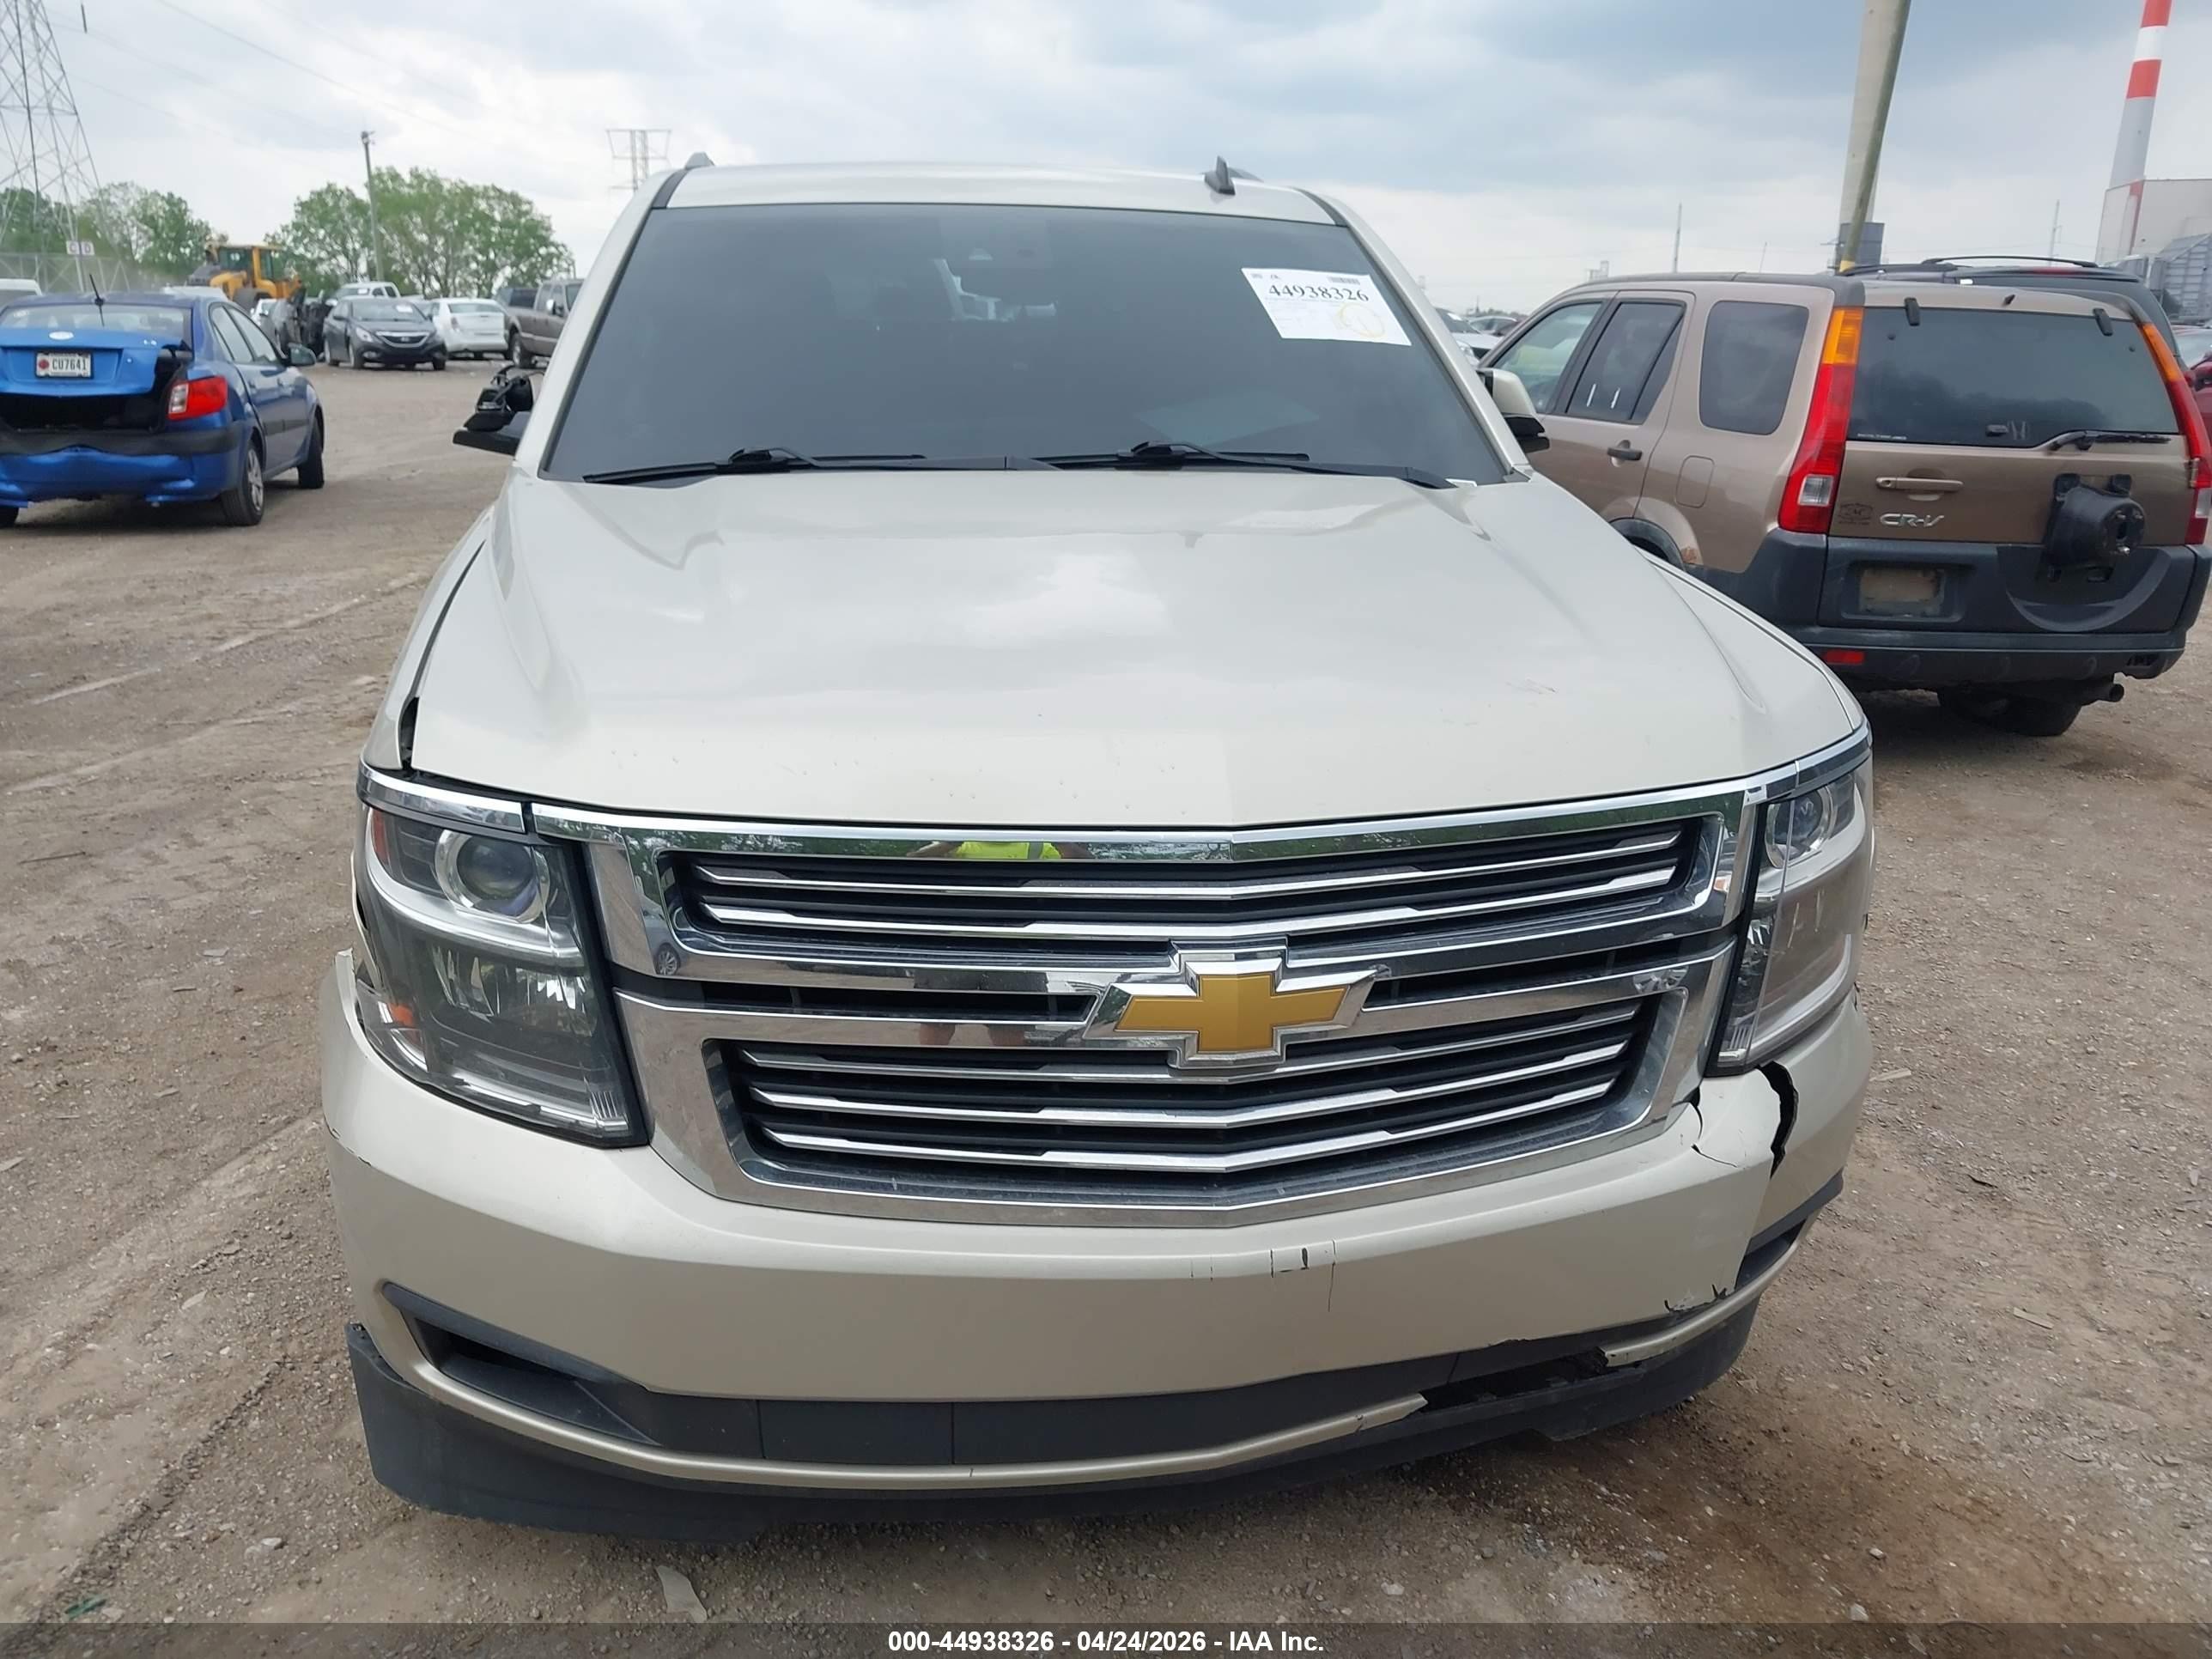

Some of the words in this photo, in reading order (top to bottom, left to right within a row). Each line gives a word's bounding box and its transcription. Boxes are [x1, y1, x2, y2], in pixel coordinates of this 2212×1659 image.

[1269, 284, 1370, 302] 44938326
[52, 358, 87, 370] CU7641
[1879, 513, 1945, 527] CR-V
